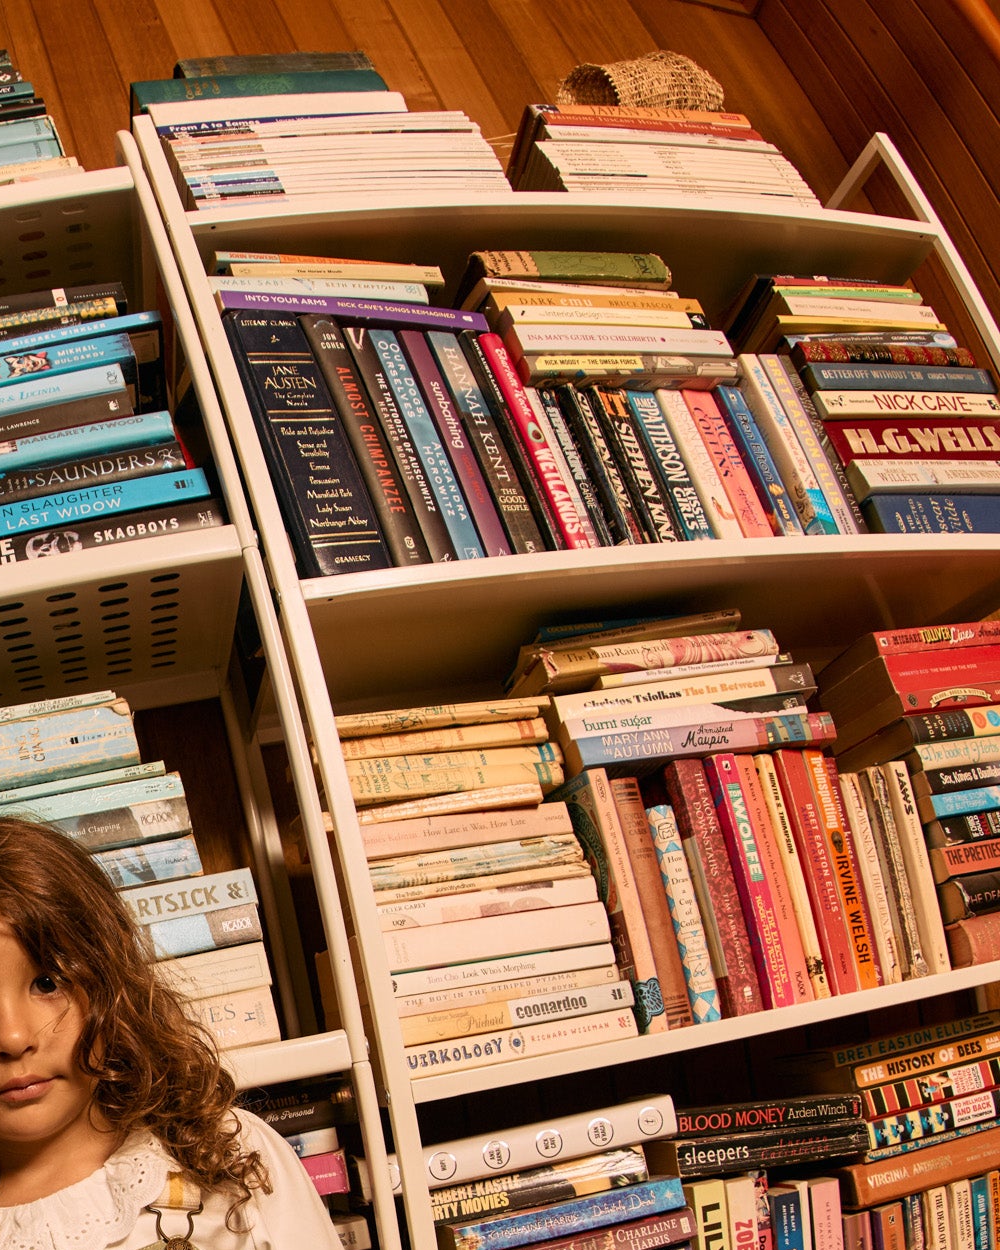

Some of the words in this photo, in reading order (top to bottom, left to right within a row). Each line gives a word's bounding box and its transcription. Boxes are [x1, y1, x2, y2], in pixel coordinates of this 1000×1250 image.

[589, 104, 639, 117] JAPAN
[643, 106, 689, 119] STYLE
[169, 124, 198, 133] From
[225, 120, 261, 128] Eames
[244, 294, 269, 303] INTO
[270, 296, 299, 305] YOUR
[300, 297, 328, 307] ARMS
[337, 301, 357, 309] NICK
[358, 303, 383, 311] CAVE'S
[384, 305, 410, 314] SONGS
[411, 308, 456, 319] REIMAGINED
[320, 341, 345, 350] COHEN
[322, 333, 337, 341] JON
[272, 365, 299, 376] JANE
[600, 359, 619, 367] OMEGA
[619, 359, 638, 367] FORCE
[264, 376, 316, 390] AUSTEN
[873, 394, 922, 412] NICK
[921, 396, 973, 412] CAVE
[442, 346, 488, 425] HANNAH
[480, 432, 511, 482] KENT
[20, 427, 88, 445] MARGARET
[89, 417, 144, 433] ATWOOD
[335, 366, 369, 425] ALMOST
[360, 424, 406, 515] CHIMPANZEE
[842, 425, 1000, 454] H.G.WELLS
[375, 372, 388, 390] THE
[383, 391, 408, 440] TATTOOIST
[402, 441, 414, 454] OF
[408, 455, 436, 513] AUSCHWITZ
[34, 451, 157, 488] SAUNDERS
[310, 462, 330, 471] Emma
[21, 484, 124, 514] SLAUGHTER
[316, 504, 332, 513] Lady
[333, 504, 353, 512] Susan
[7, 511, 50, 531] LAST
[55, 497, 122, 519] WIDOW
[93, 518, 180, 543] SKAGBOYS
[335, 554, 371, 564] GRAMERCY
[583, 719, 619, 732] burnt
[621, 715, 653, 730] sugar
[681, 732, 729, 749] Maupin
[808, 754, 839, 829] Trainspotting
[895, 769, 914, 816] JAWS
[836, 853, 858, 906] IRVINE
[849, 911, 871, 964] WELSH
[515, 995, 587, 1019] coonardoo
[679, 1113, 732, 1133] BLOOD
[734, 1107, 786, 1128] MONEY
[787, 1107, 817, 1120] Arden
[819, 1103, 848, 1116] Winch
[684, 1144, 750, 1166] sleepers
